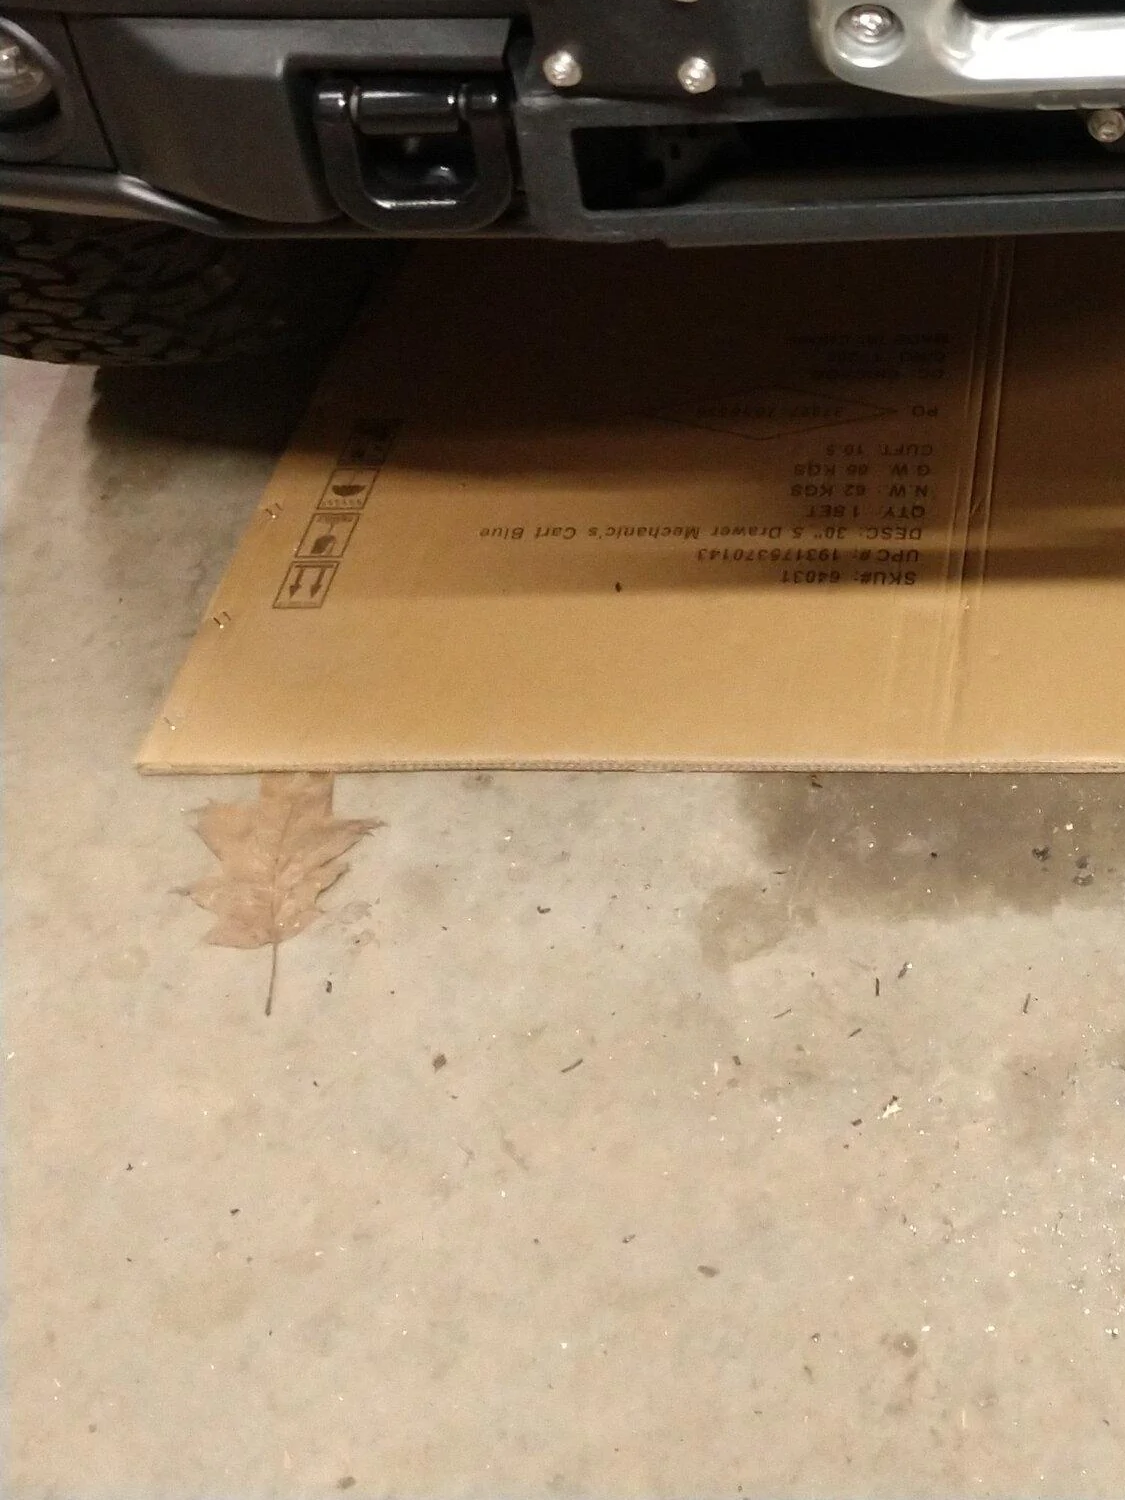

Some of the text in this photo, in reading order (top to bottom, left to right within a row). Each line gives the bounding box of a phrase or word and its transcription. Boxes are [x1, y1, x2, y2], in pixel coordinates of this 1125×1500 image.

[790, 484, 833, 497] KGS
[478, 526, 525, 540] Blue
[534, 526, 577, 540] Cart
[587, 526, 700, 540] Mechanic's
[710, 526, 782, 539] Drawer
[792, 526, 804, 538] 5
[780, 570, 841, 584] 64031
